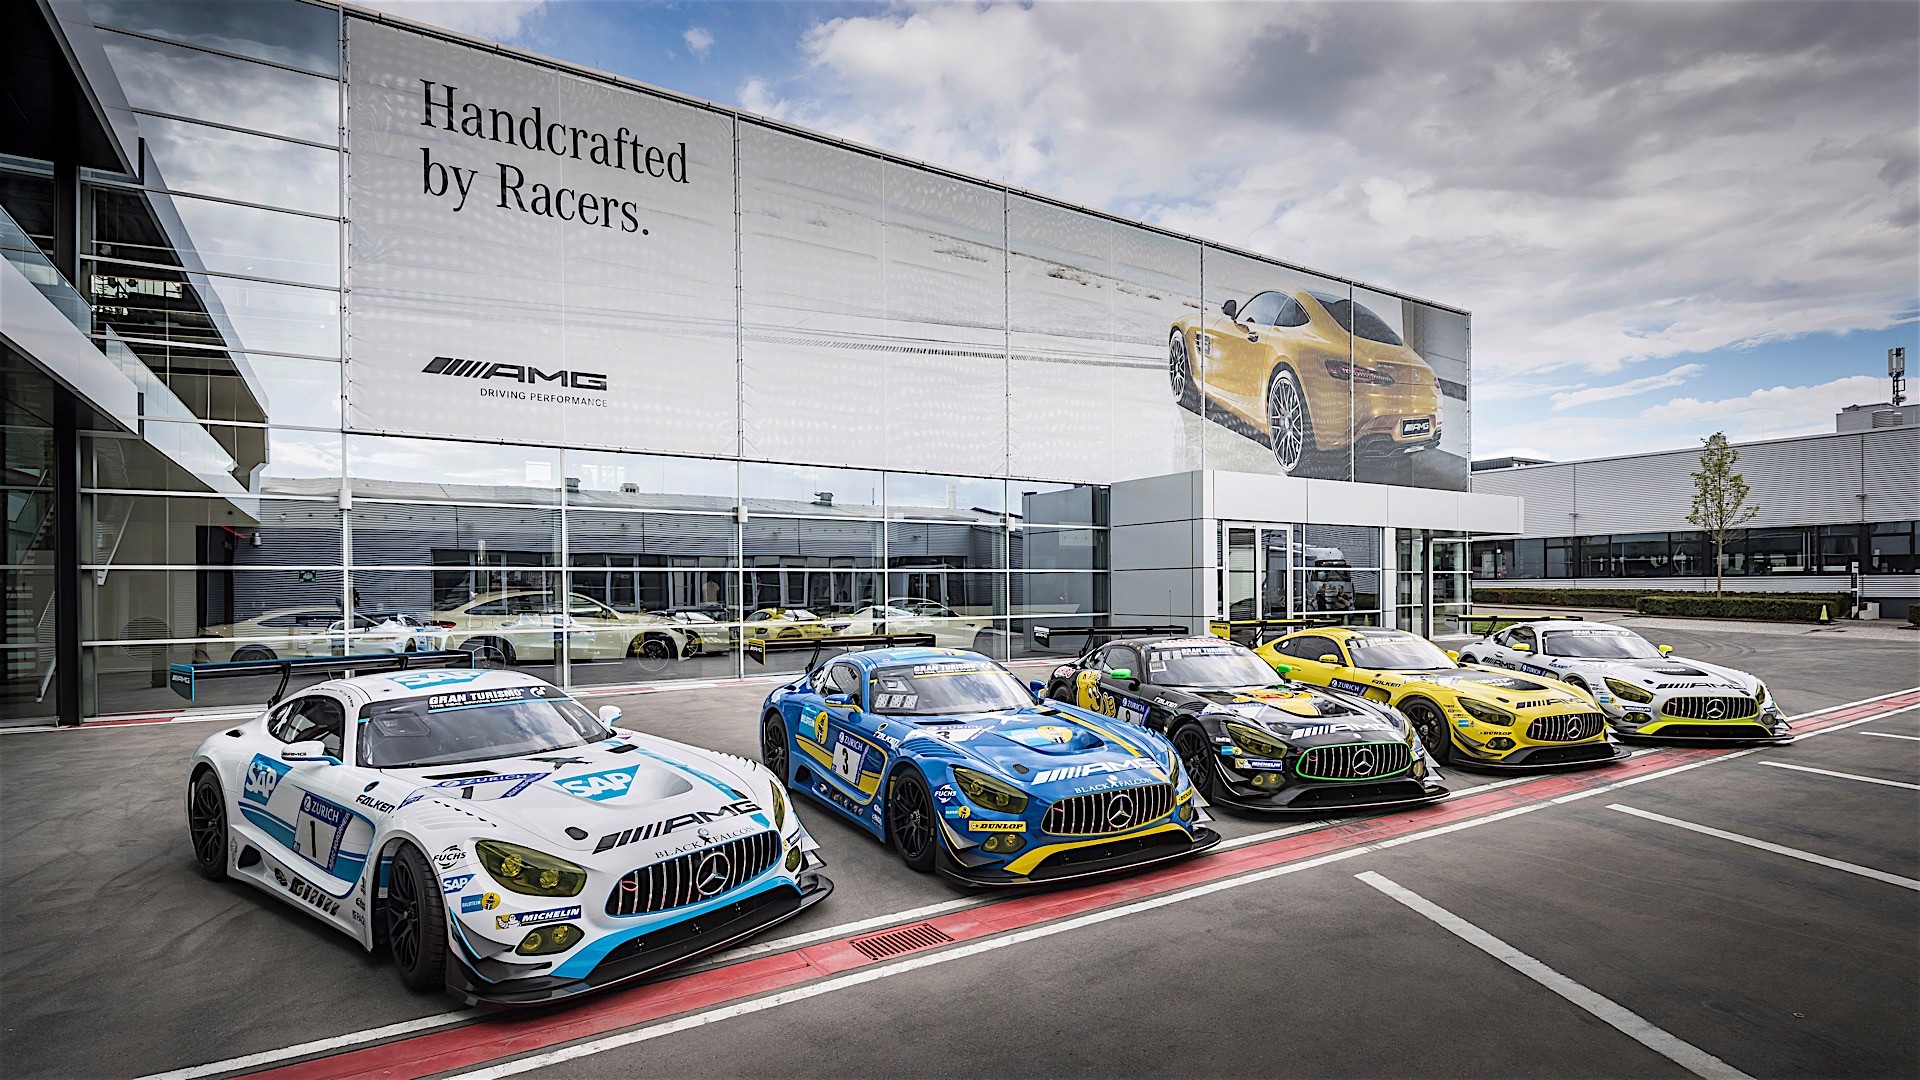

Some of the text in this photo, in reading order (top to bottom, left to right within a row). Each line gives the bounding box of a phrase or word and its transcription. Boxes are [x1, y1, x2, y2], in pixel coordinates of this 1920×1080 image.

[419, 78, 690, 184] Handcrafted
[419, 147, 650, 236] by Racers.
[481, 362, 607, 391] AMG
[480, 388, 608, 407] DRIVING PERFORMANCE
[1494, 660, 1516, 670] AMG
[393, 672, 479, 686] SAP
[1337, 681, 1359, 692] ZURICH
[1371, 679, 1402, 688] FALKEN
[428, 688, 523, 705] GRAN TURISMO
[1154, 697, 1178, 708] FALKEN
[1127, 700, 1145, 713] ZURICH
[844, 735, 863, 751] ZURICH
[842, 748, 849, 775] 3
[245, 761, 278, 800] SAP
[463, 773, 528, 784] ZURICH
[567, 771, 632, 799] SAP
[1074, 776, 1153, 794] BLACK FALCON
[461, 786, 475, 800] 1
[311, 800, 340, 823] ZURICH
[355, 794, 396, 814] FALKEN
[310, 820, 317, 859] 1
[655, 825, 756, 859] BLACK FALCON
[433, 851, 467, 862] FUCHS
[443, 877, 469, 891] SAP
[521, 908, 580, 923] MICHELIN
